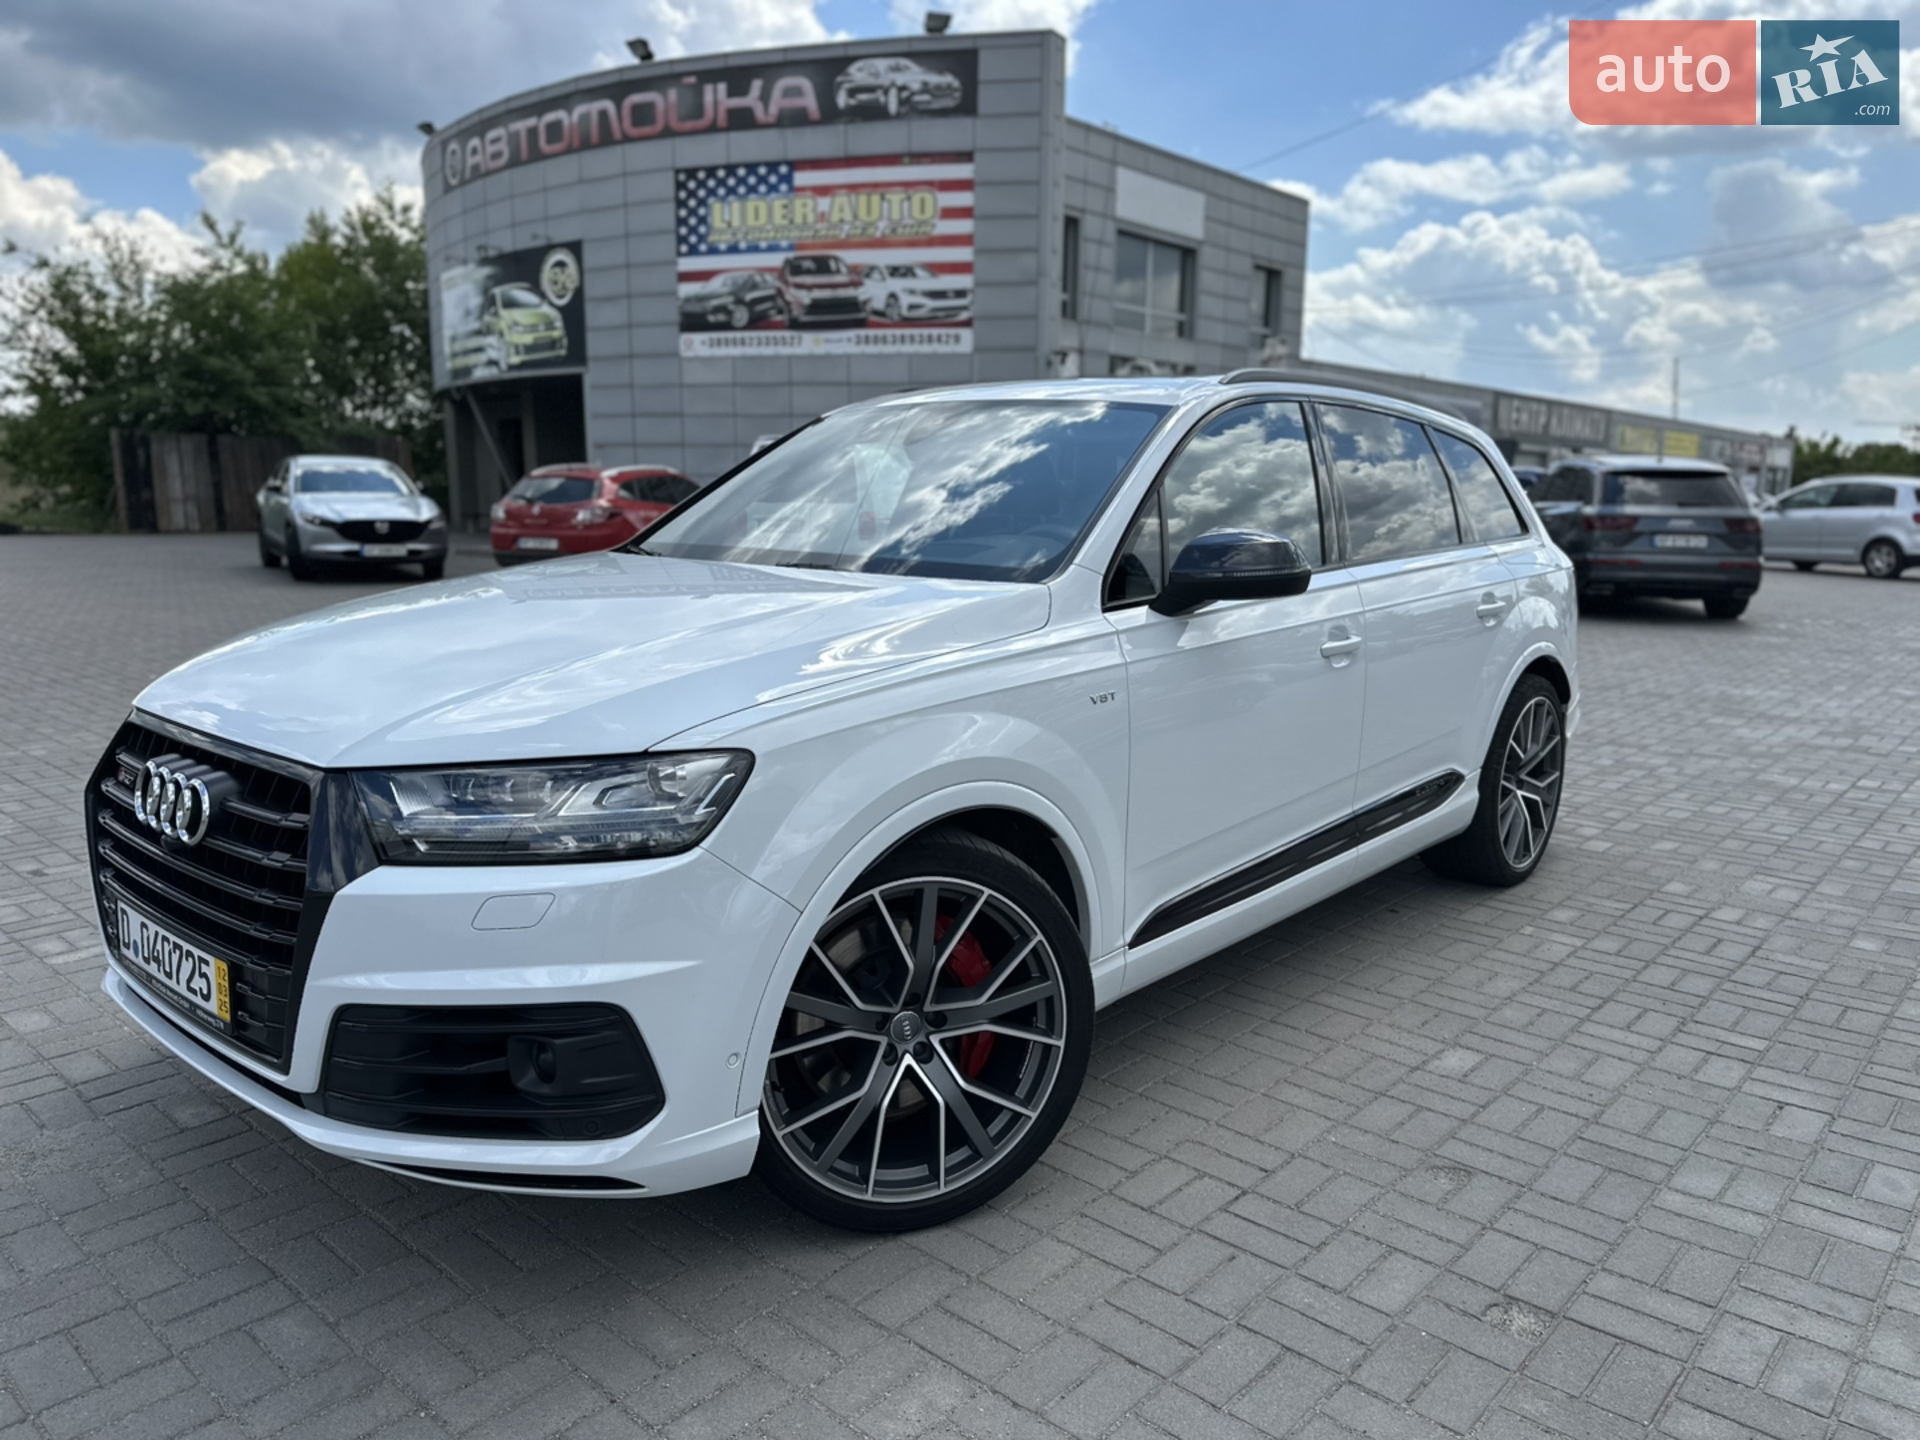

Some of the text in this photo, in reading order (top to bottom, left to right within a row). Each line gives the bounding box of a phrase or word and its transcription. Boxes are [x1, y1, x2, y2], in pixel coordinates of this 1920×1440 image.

[464, 75, 821, 181] АВТОМОЙКА
[709, 187, 937, 230] LIDER AUTO
[120, 906, 131, 951] D
[140, 920, 212, 1003] 040725
[216, 966, 228, 982] 12
[218, 998, 229, 1014] 25
